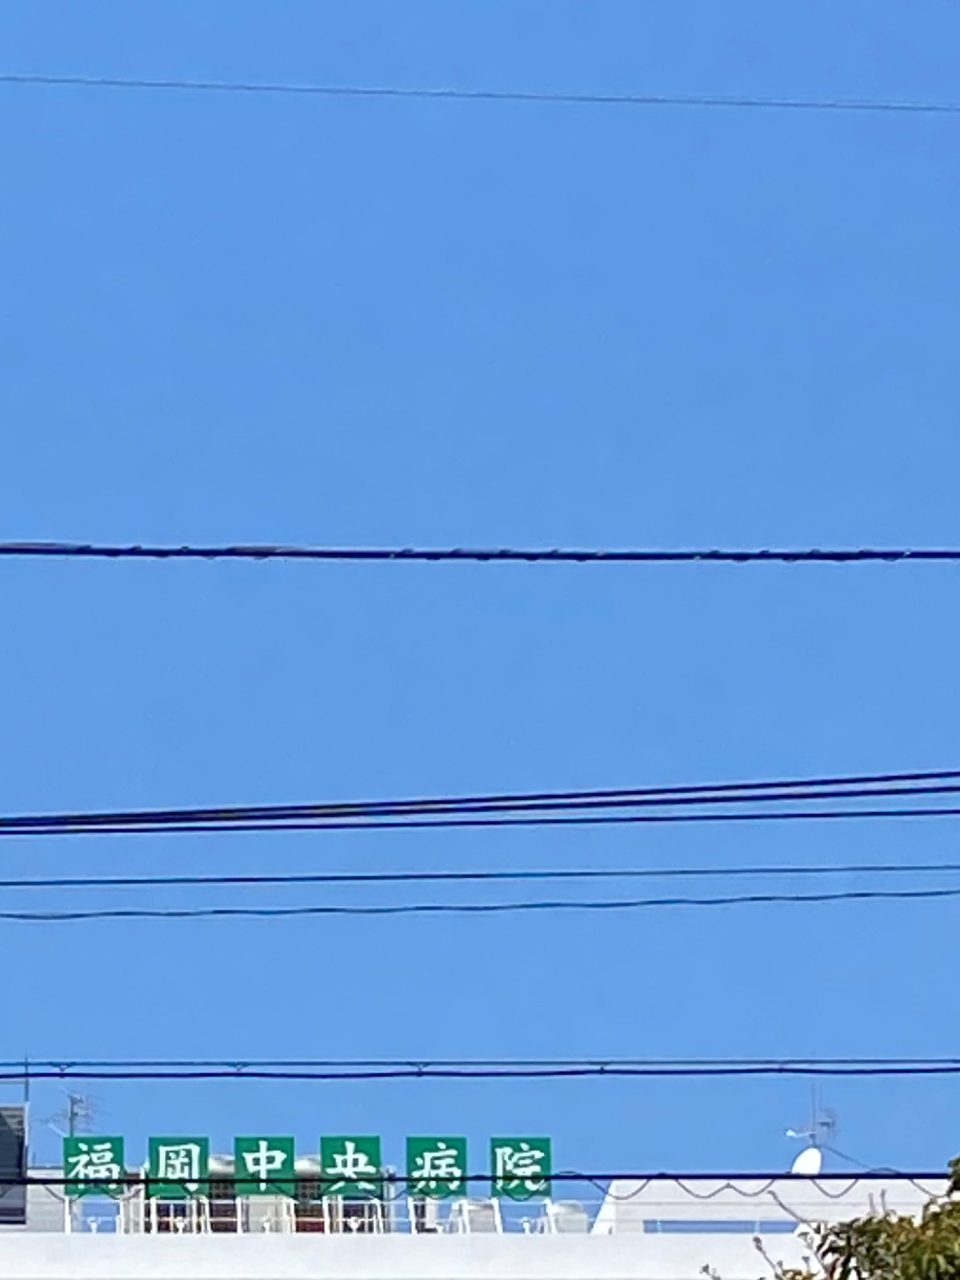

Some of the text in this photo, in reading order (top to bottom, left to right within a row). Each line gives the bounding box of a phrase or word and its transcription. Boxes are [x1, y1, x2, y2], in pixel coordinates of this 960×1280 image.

[66, 1140, 546, 1192] 福岡中央病院
